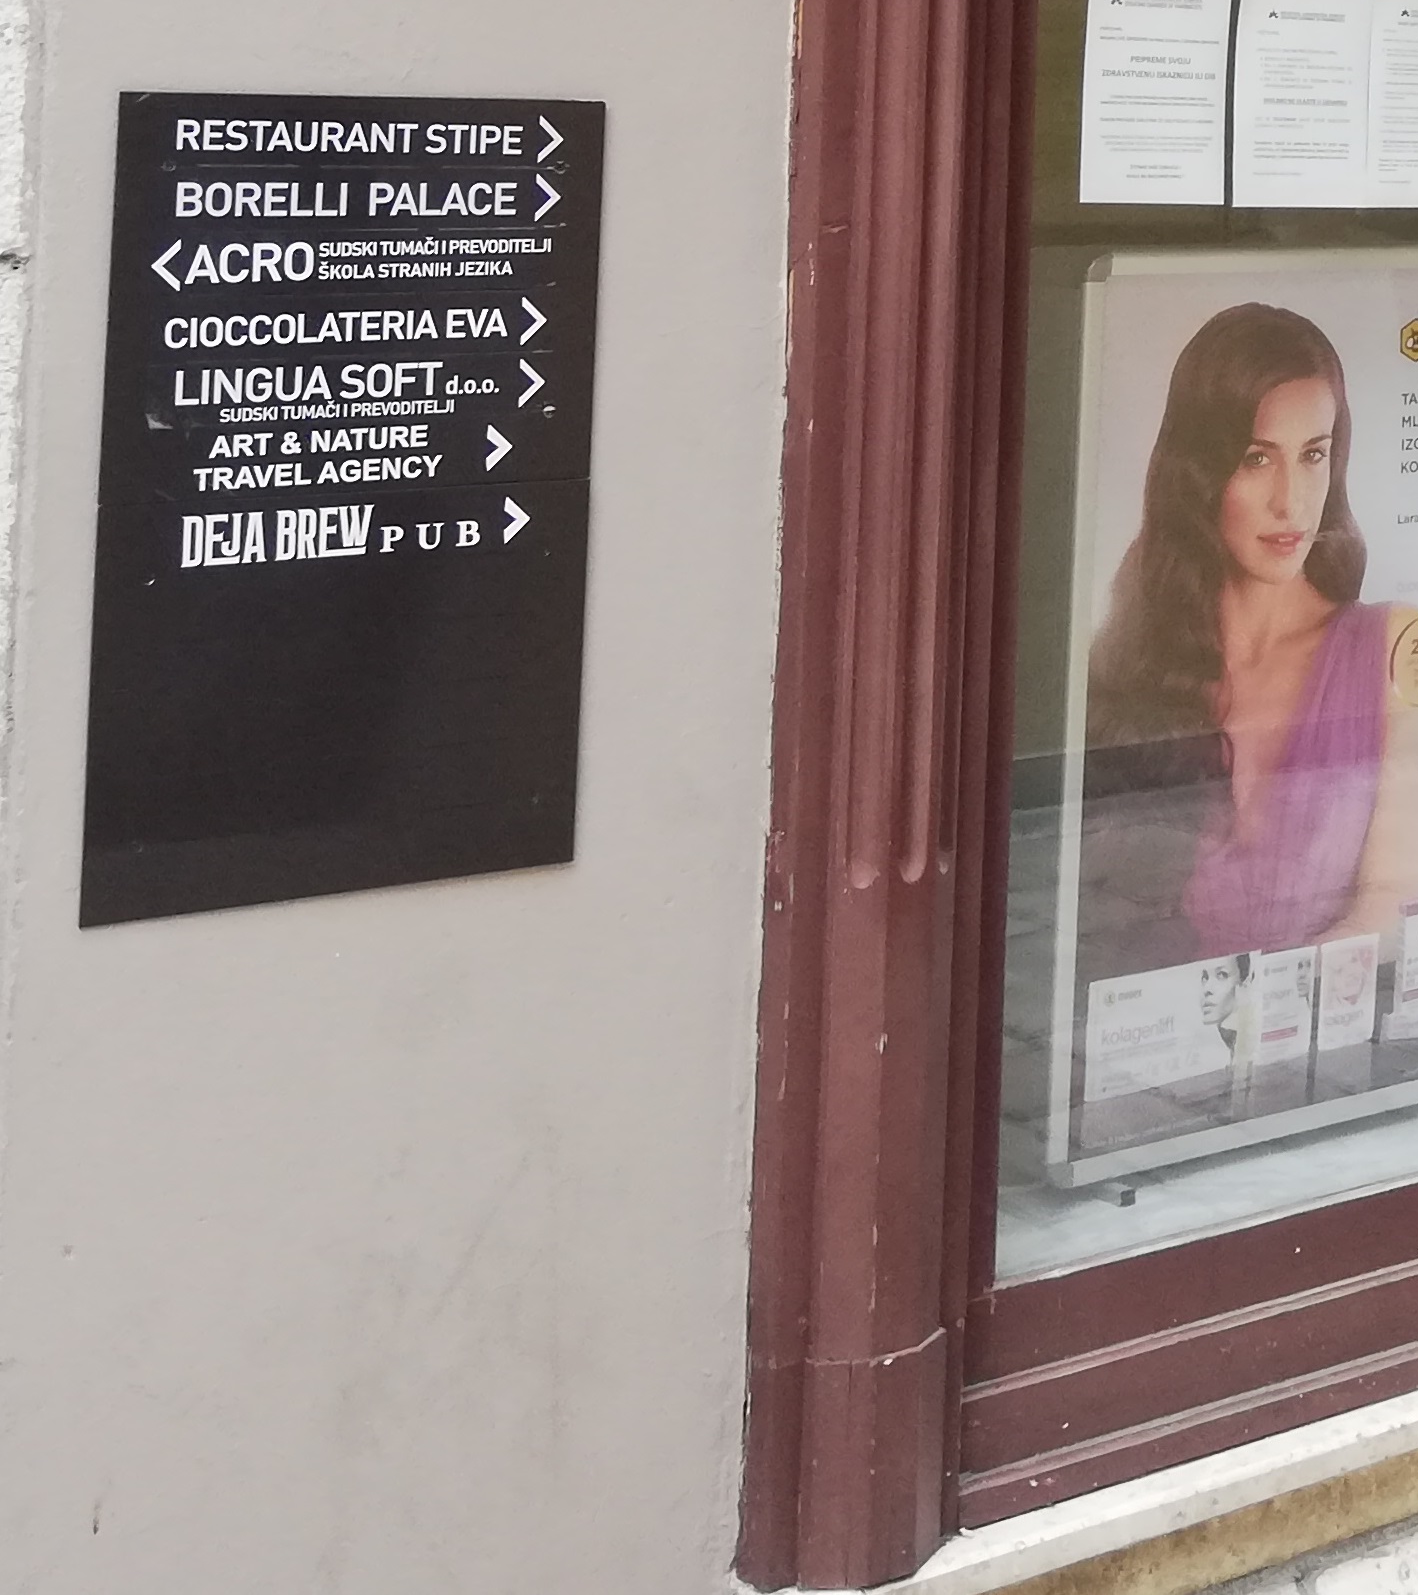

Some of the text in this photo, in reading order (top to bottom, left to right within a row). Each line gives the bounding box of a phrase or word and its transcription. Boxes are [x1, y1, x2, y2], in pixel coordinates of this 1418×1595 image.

[175, 119, 524, 155] RESTAURANT STIPE
[174, 181, 518, 218] BORELLI PALACE
[185, 242, 315, 284] ACRO
[319, 236, 552, 258] SUDSKI TUMAČI I PREVODITELJI
[318, 260, 514, 281] ŠKOLA STRANIH JEZIKA
[163, 308, 508, 349] CIOCCOLATERIA EVA
[174, 362, 500, 406] LINGUA SOFT d.o.o.
[219, 399, 455, 423] SUDSKI TUMAČI I PREVODITELJI
[208, 425, 429, 459] ART & NATURE
[193, 455, 443, 492] TRAVEL AGENCY
[180, 512, 267, 568] DEJA
[275, 504, 375, 562] BREW
